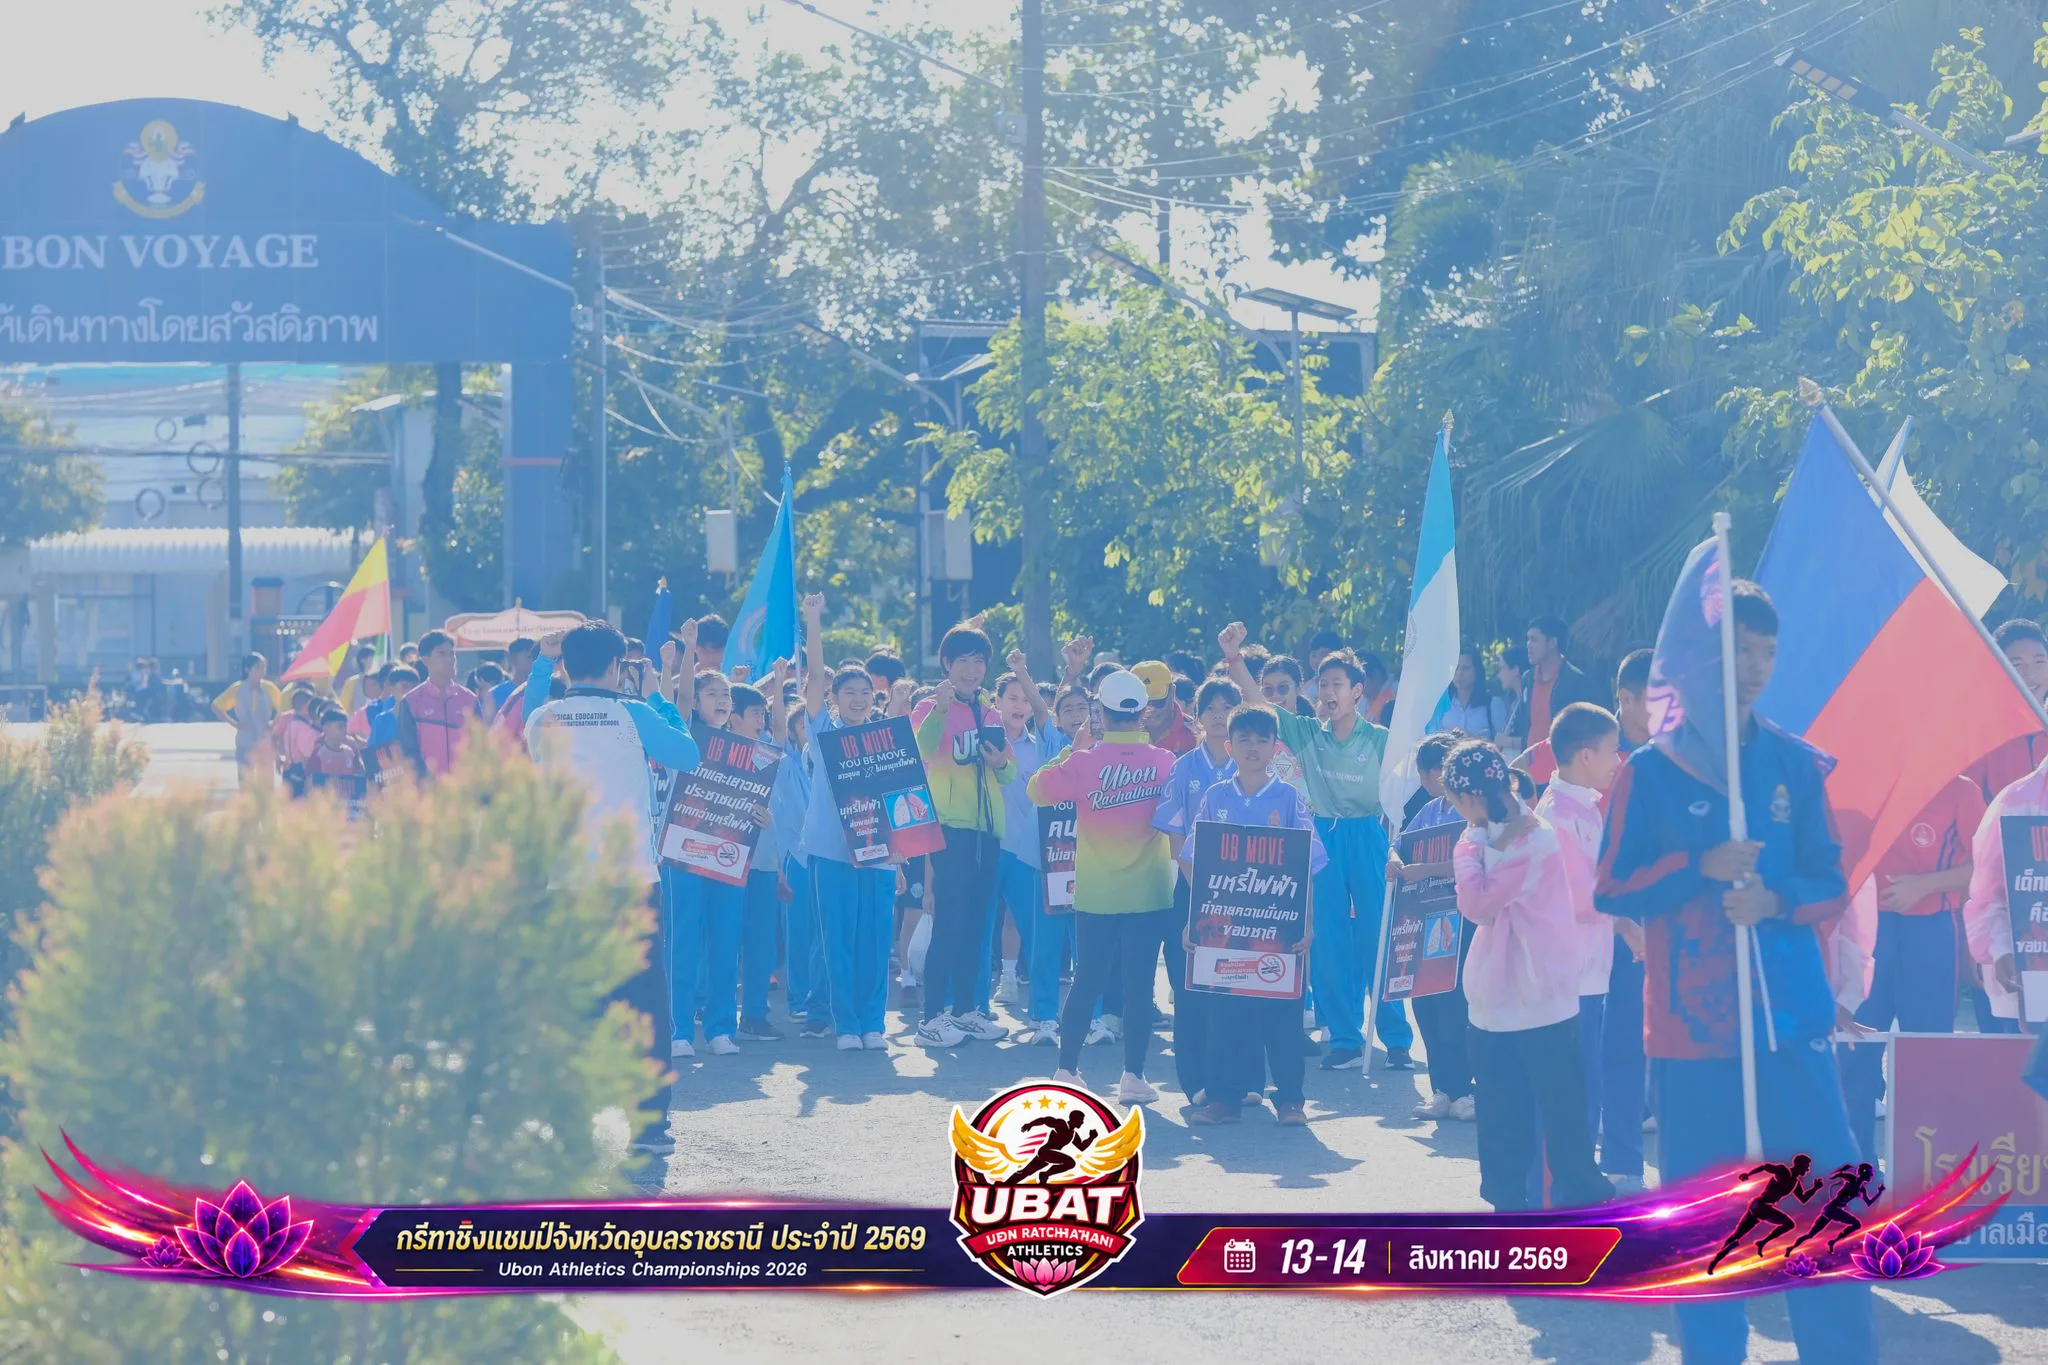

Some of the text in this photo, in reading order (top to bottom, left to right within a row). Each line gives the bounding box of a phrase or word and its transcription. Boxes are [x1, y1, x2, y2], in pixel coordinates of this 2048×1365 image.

[2, 233, 319, 269] BON VOYAGE
[575, 712, 608, 720] EDUCATION
[706, 735, 725, 761] UB
[841, 727, 896, 759] UB MOVE
[840, 748, 907, 770] YOU BE MOVE
[1098, 763, 1158, 792] Ubon
[684, 783, 757, 814] ประชาชนมีค่
[840, 799, 881, 820] บุหรี่ไฟฟ้า
[1052, 801, 1074, 811] YOU
[1221, 833, 1285, 866] UB MOVE
[1207, 866, 1299, 900] บุหรี่ไฟฟ้า
[1200, 900, 1299, 922] ทำลายความมั่นคง
[1223, 924, 1278, 941] ของชาติ
[1915, 1126, 2048, 1196] โรงเรีย
